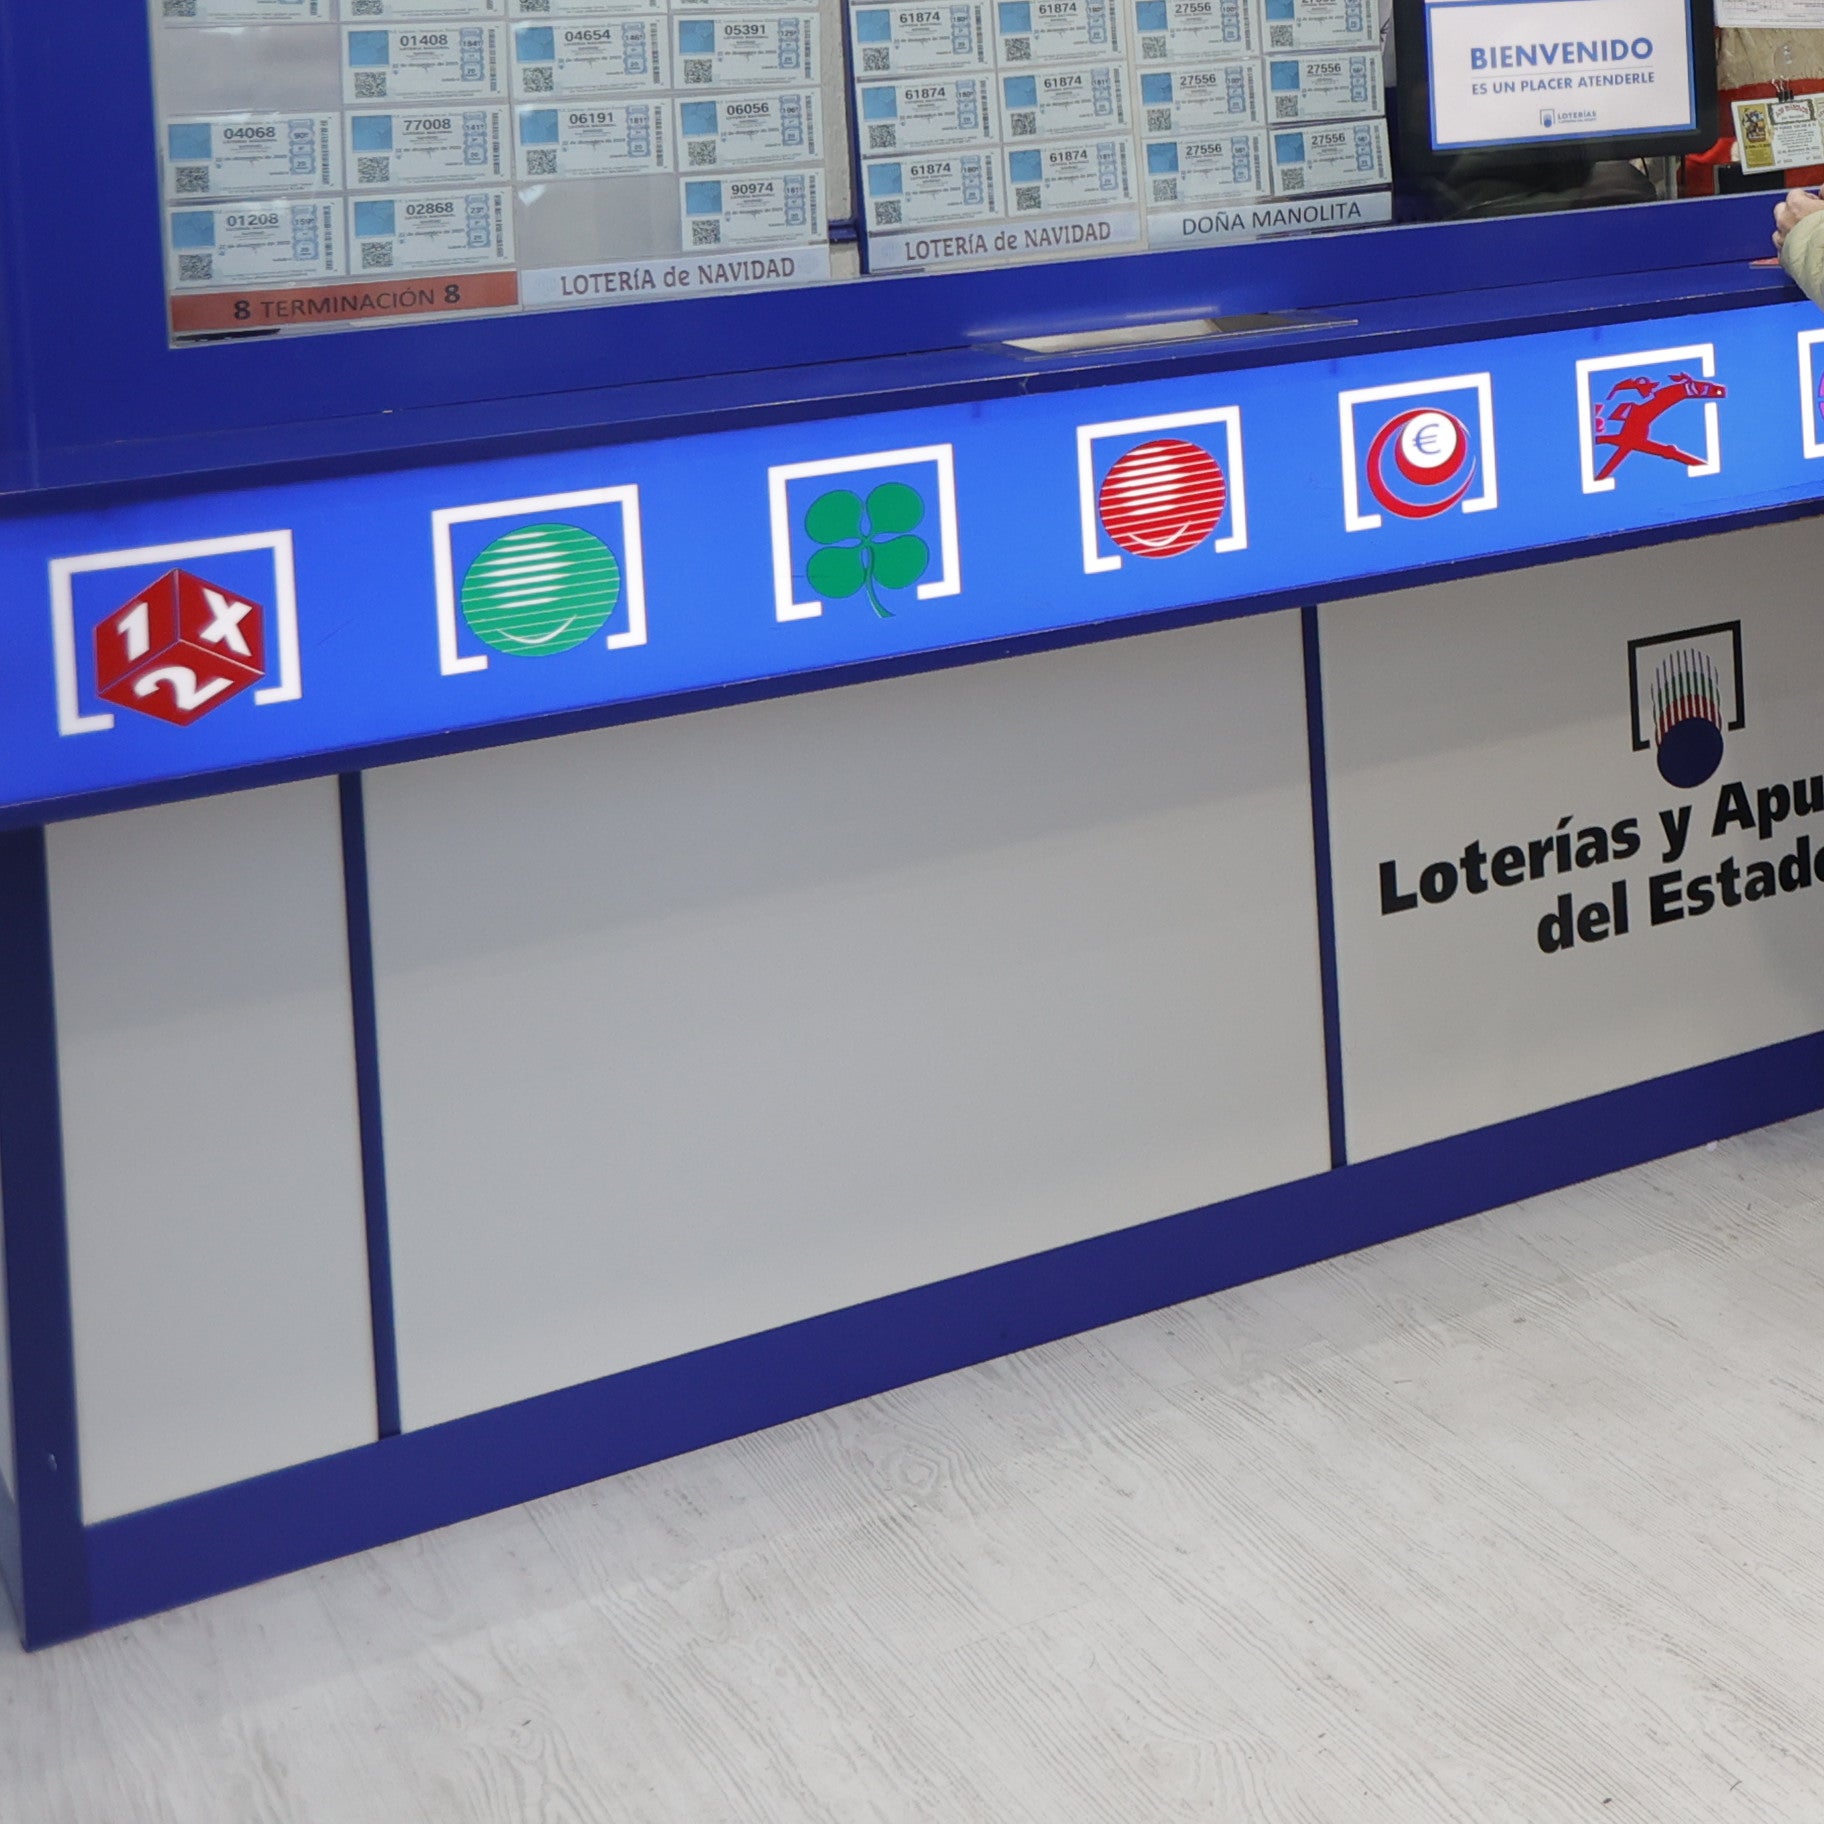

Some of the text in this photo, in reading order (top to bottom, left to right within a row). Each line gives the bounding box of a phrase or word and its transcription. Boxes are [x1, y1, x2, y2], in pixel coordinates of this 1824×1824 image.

[1470, 37, 1654, 71] BIENVENIDO
[1472, 72, 1656, 96] ES UN PLACER ATENDERLE
[1182, 201, 1361, 237] DOÑA MANOLITA
[903, 221, 1112, 262] LOTERÍA de NAVIDAD
[559, 255, 795, 297] LOTERÍA de NAVIDAD
[233, 283, 462, 322] 8 TERMINACIÓN 8
[1378, 814, 1642, 916] Loterías
[1659, 804, 1692, 864] y
[1536, 880, 1630, 954] del
